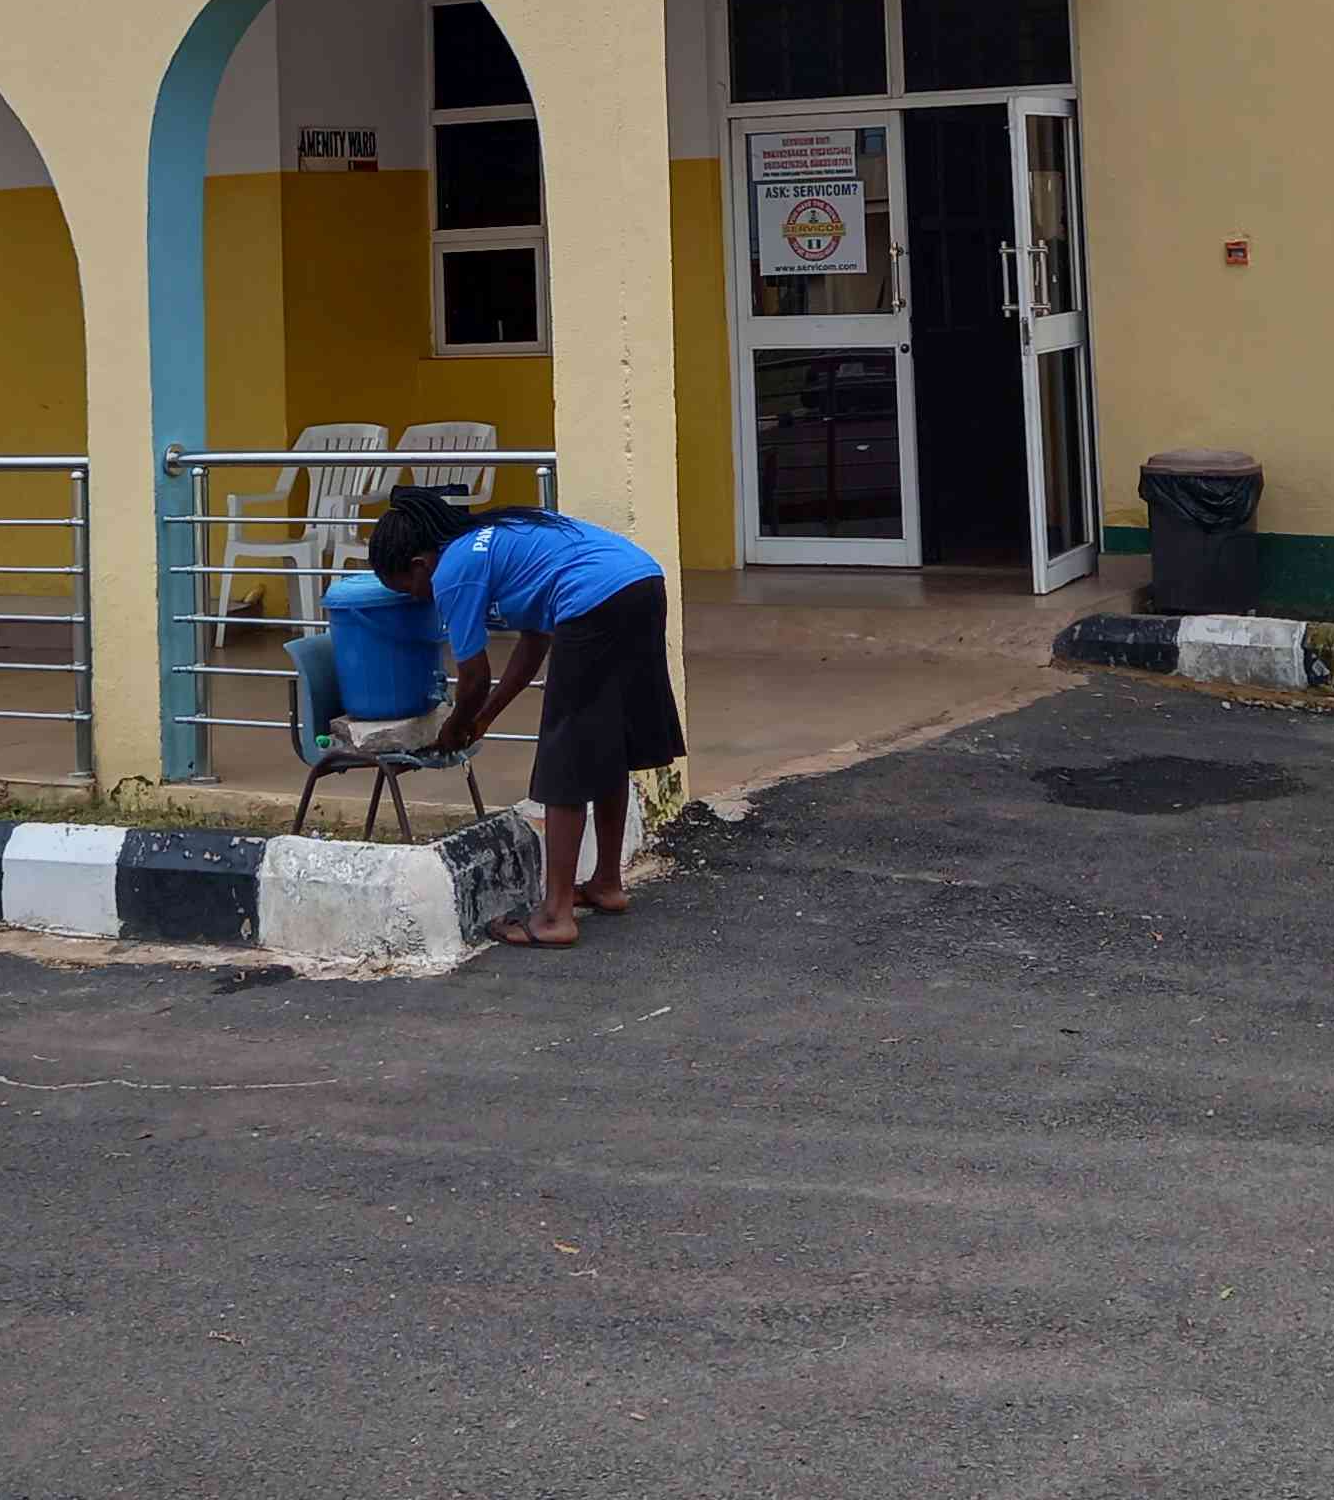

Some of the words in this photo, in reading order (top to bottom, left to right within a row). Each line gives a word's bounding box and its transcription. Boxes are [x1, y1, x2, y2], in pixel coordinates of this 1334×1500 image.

[298, 130, 346, 158] AMENITY
[347, 131, 376, 158] WARD
[765, 186, 790, 199] ASK:
[793, 183, 859, 198] SERVICOM?
[472, 525, 495, 552] PAK
